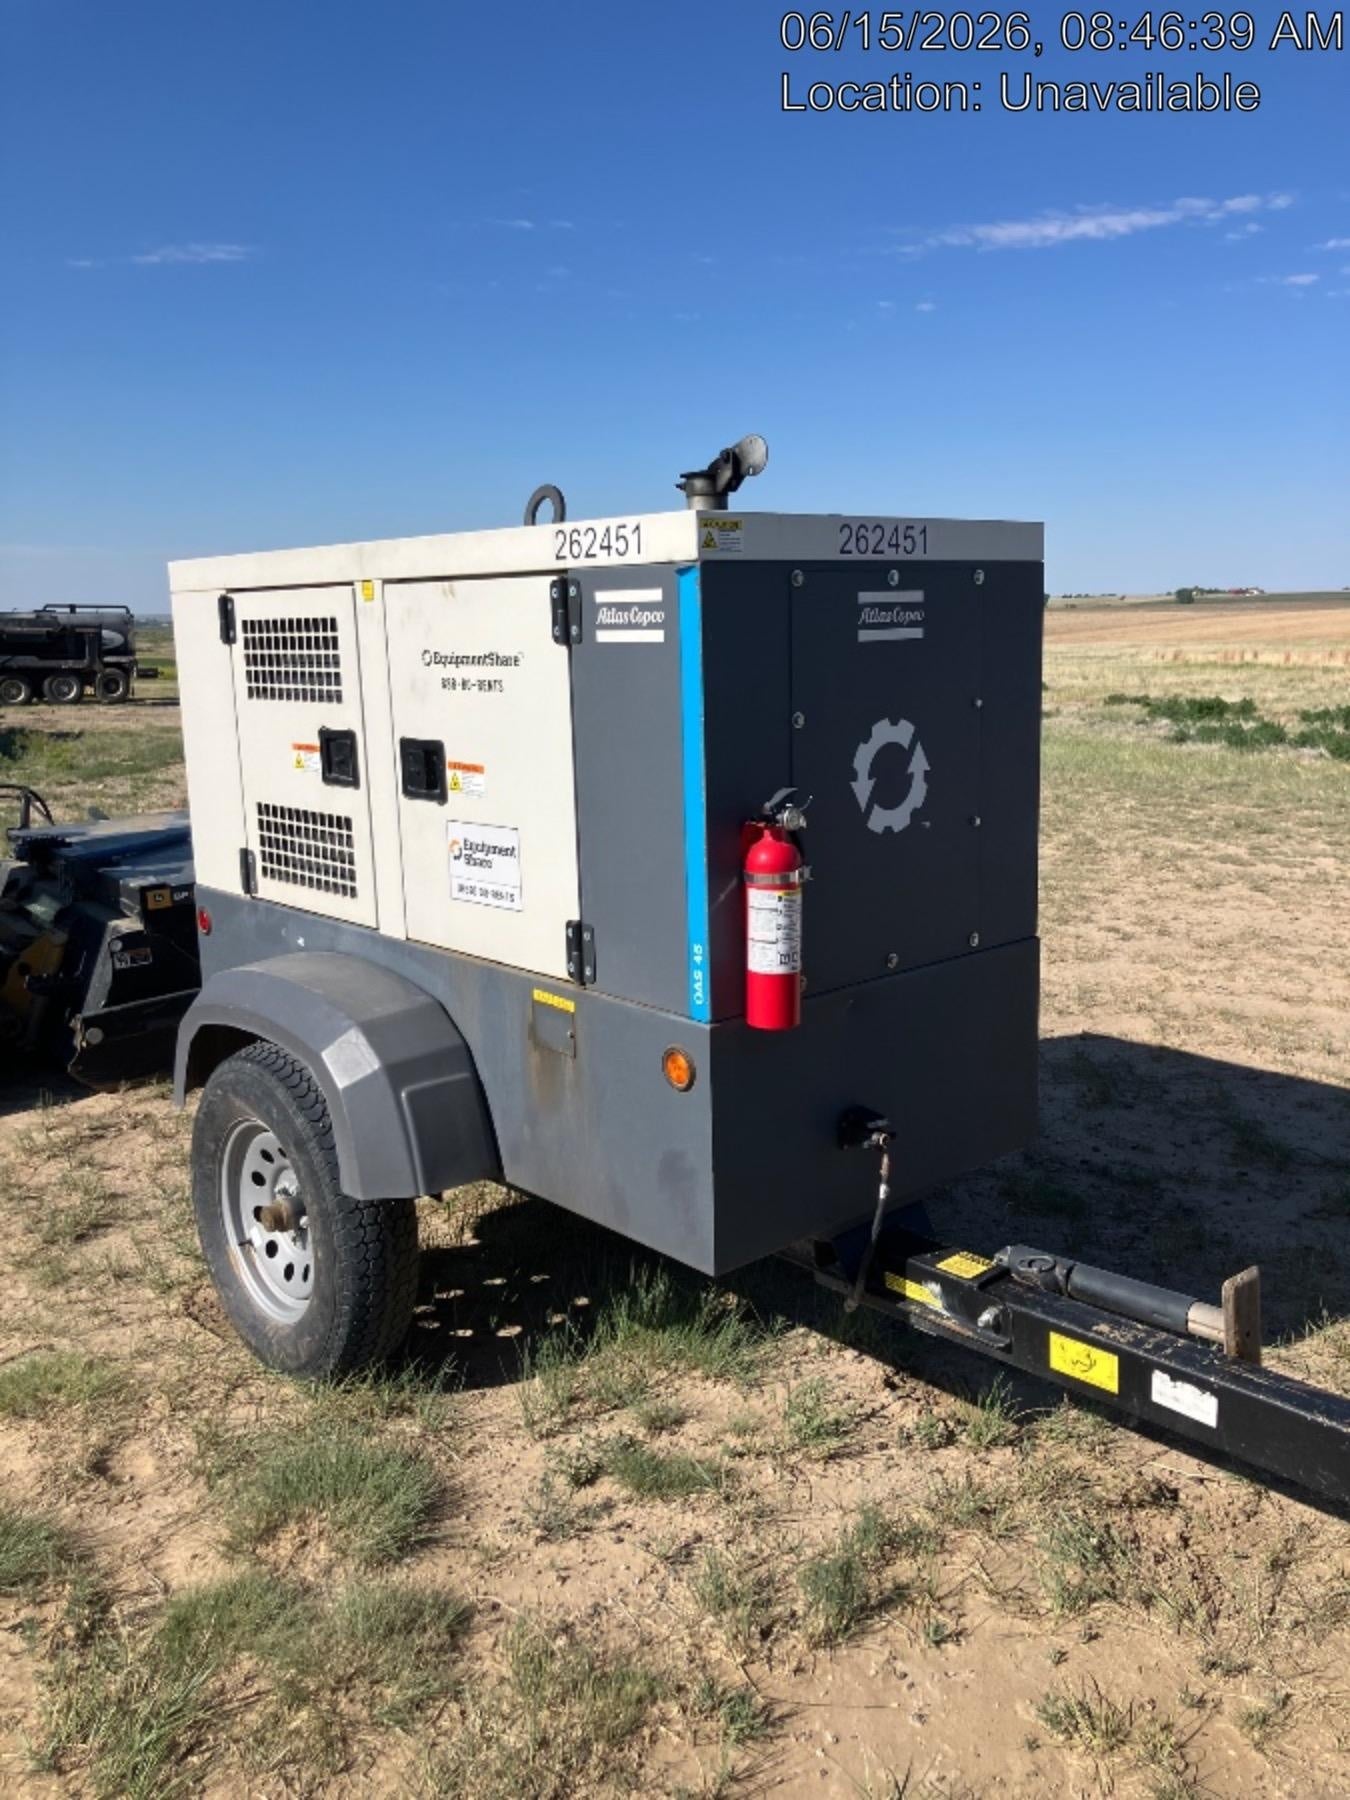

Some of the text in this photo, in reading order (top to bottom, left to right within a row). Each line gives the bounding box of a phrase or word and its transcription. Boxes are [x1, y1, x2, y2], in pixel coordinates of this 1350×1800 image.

[555, 523, 642, 560] 262451
[839, 523, 928, 555] 262451
[692, 943, 704, 964] 45
